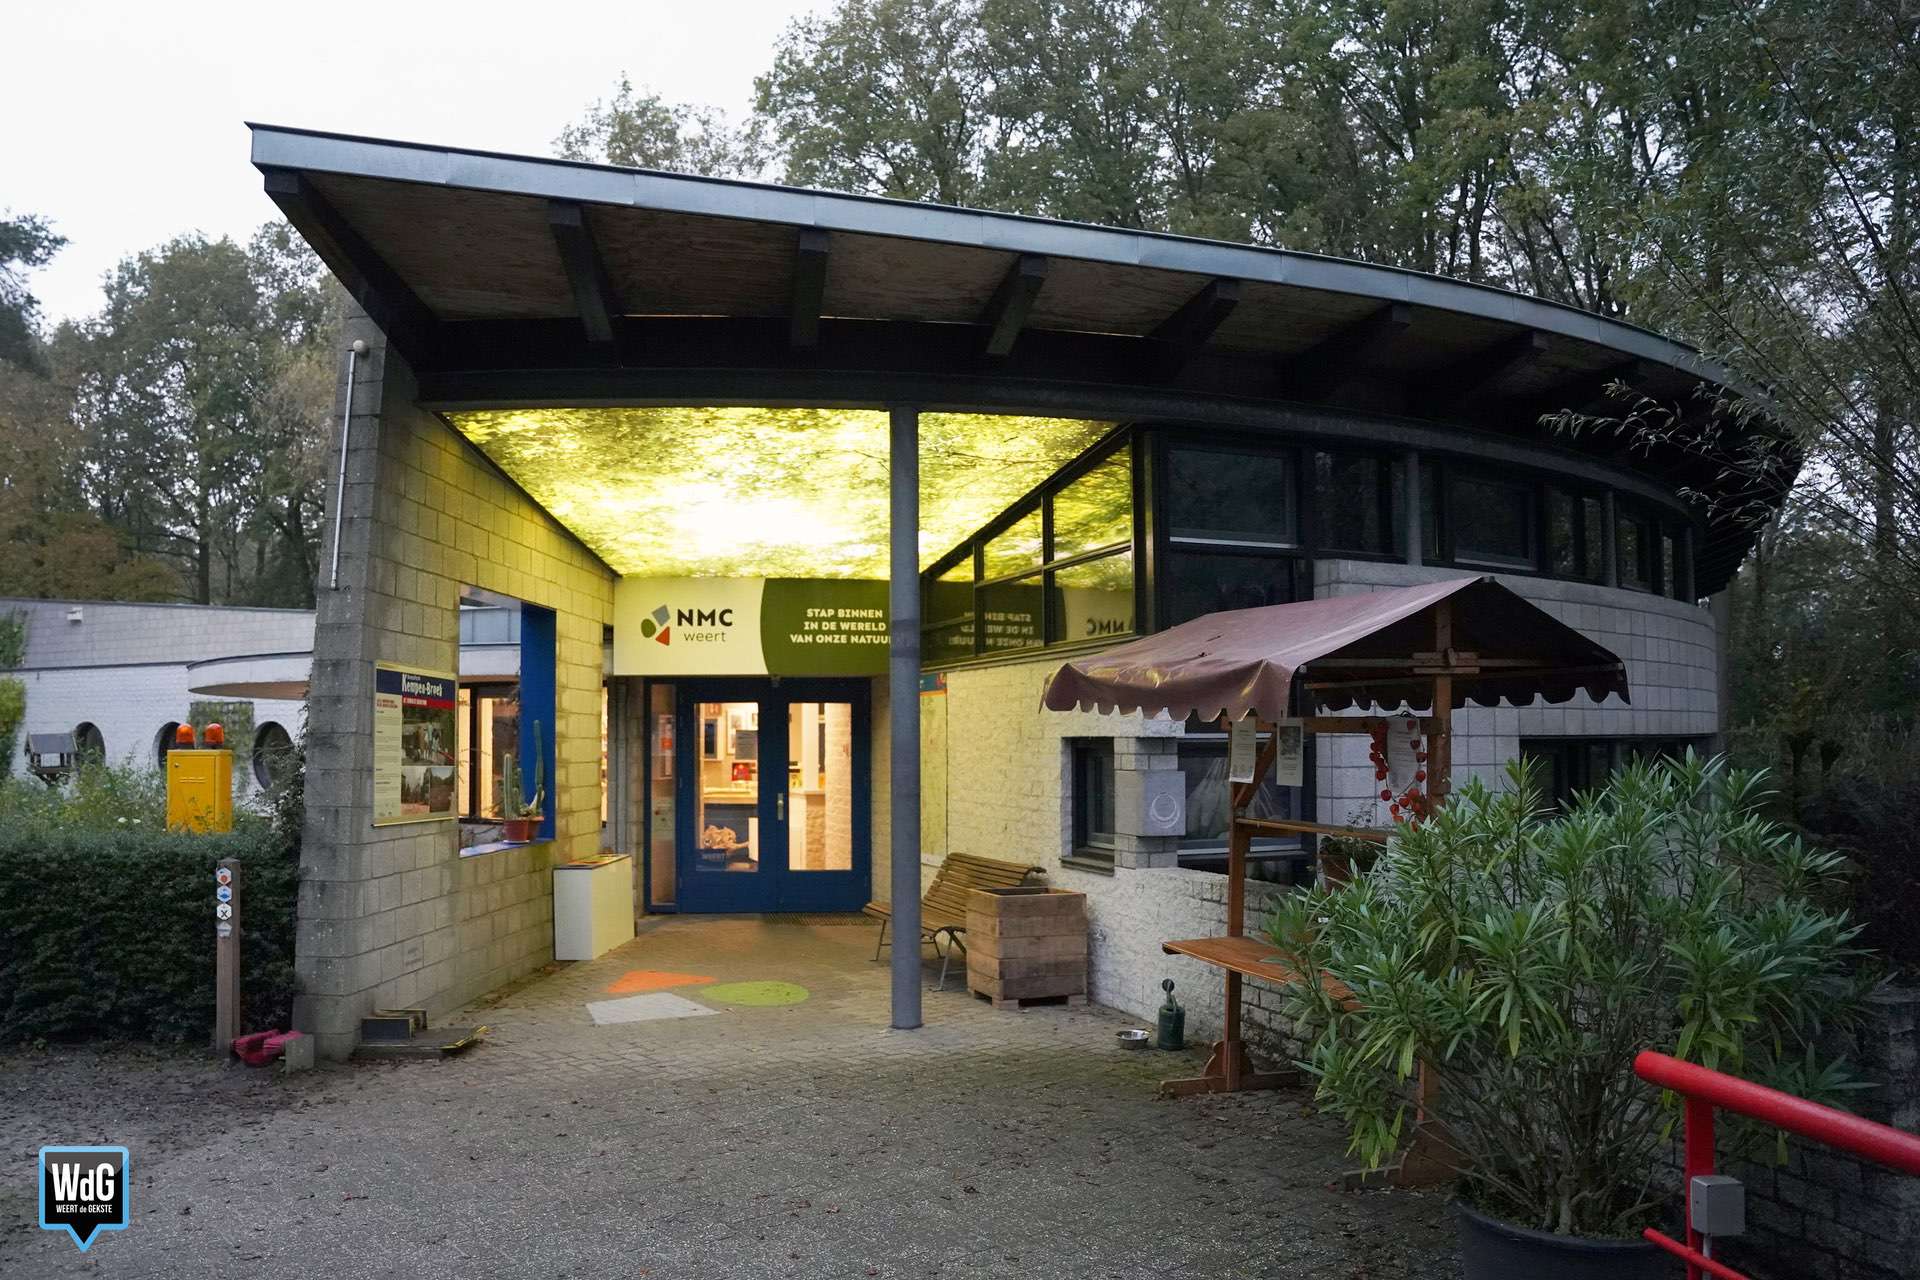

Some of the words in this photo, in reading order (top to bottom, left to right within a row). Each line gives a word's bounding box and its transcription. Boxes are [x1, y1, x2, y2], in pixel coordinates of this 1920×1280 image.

[677, 608, 733, 627] NMC
[806, 607, 835, 618] STAP
[837, 608, 883, 619] BINNEN
[804, 621, 819, 631] IN
[821, 621, 837, 631] DE
[840, 621, 887, 632] WERELD
[684, 631, 726, 642] weert
[789, 633, 813, 644] VAN
[816, 634, 848, 644] ONZE
[850, 635, 889, 645] NATUU
